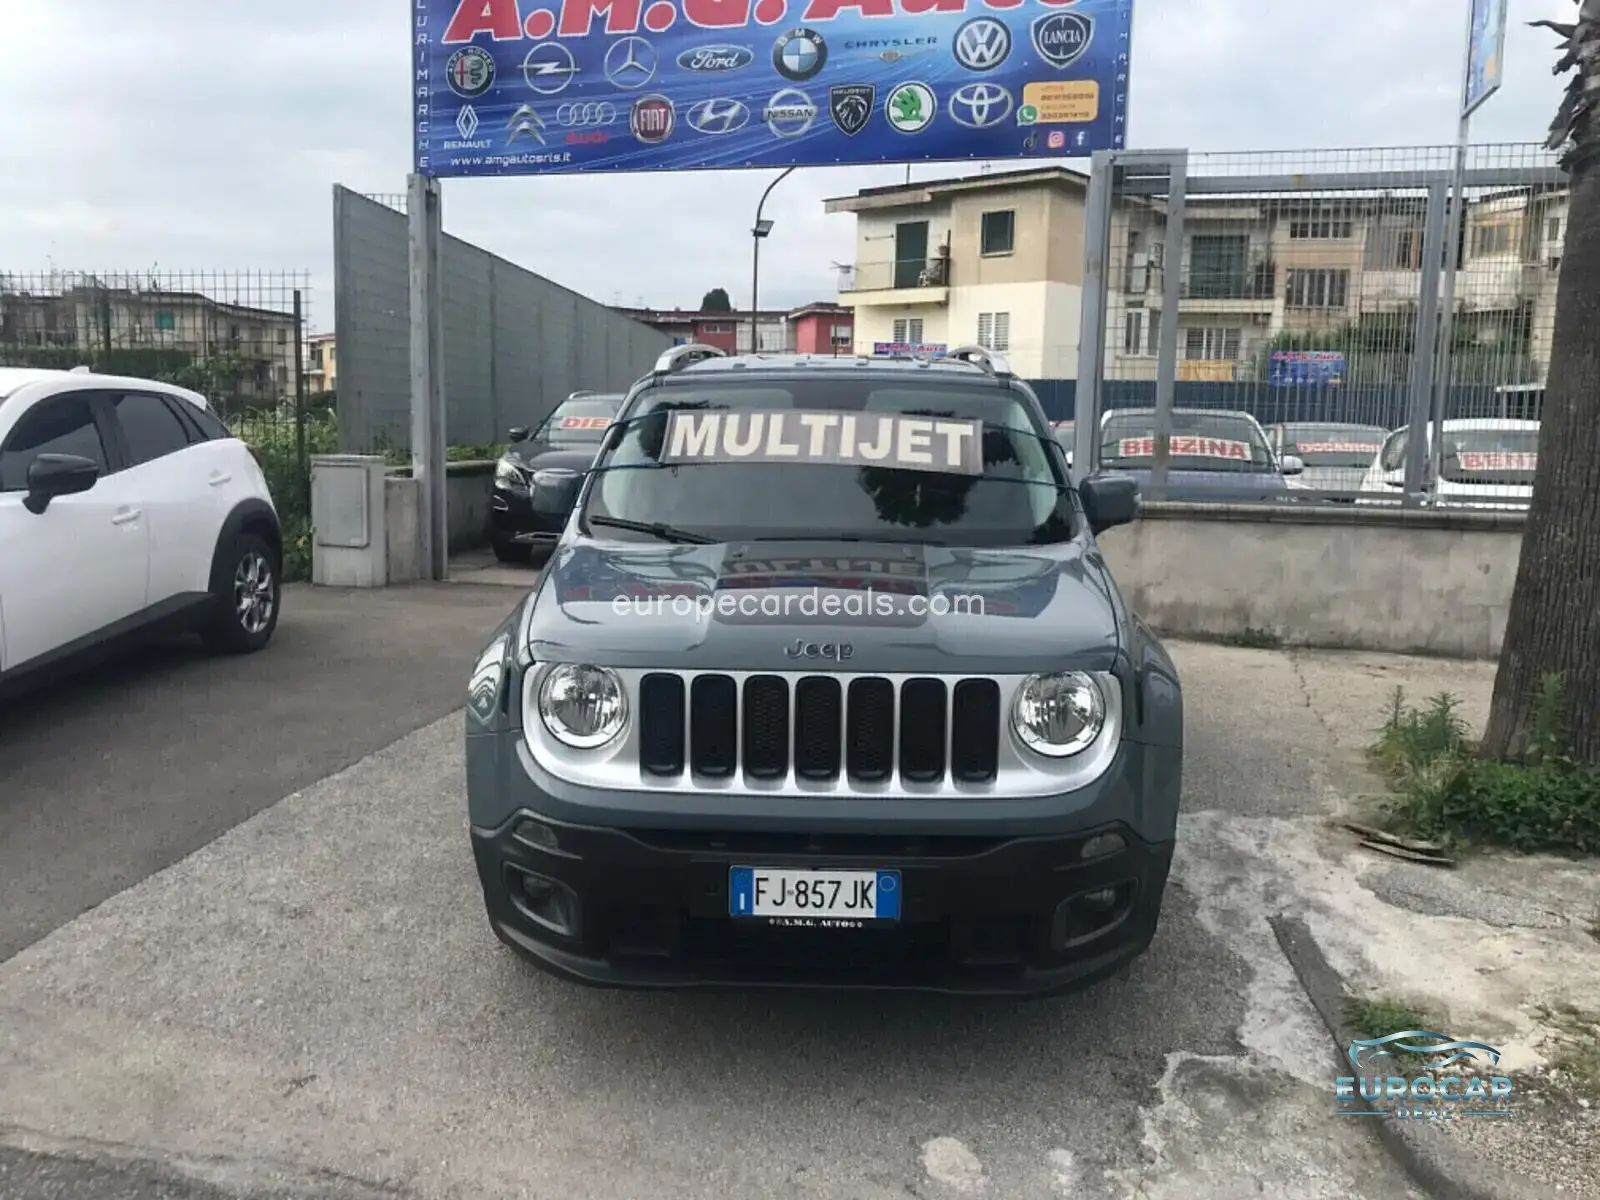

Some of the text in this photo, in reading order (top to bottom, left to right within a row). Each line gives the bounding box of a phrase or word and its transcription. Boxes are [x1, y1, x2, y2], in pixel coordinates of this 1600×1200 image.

[844, 36, 937, 49] CHRYSLER
[1044, 29, 1082, 44] LANCIA
[691, 48, 740, 69] Ford
[639, 108, 666, 131] FIAT
[767, 108, 813, 119] NISSAN
[443, 139, 493, 150] RENAULT
[670, 412, 974, 466] MULTIJET
[784, 638, 854, 663] Jeep
